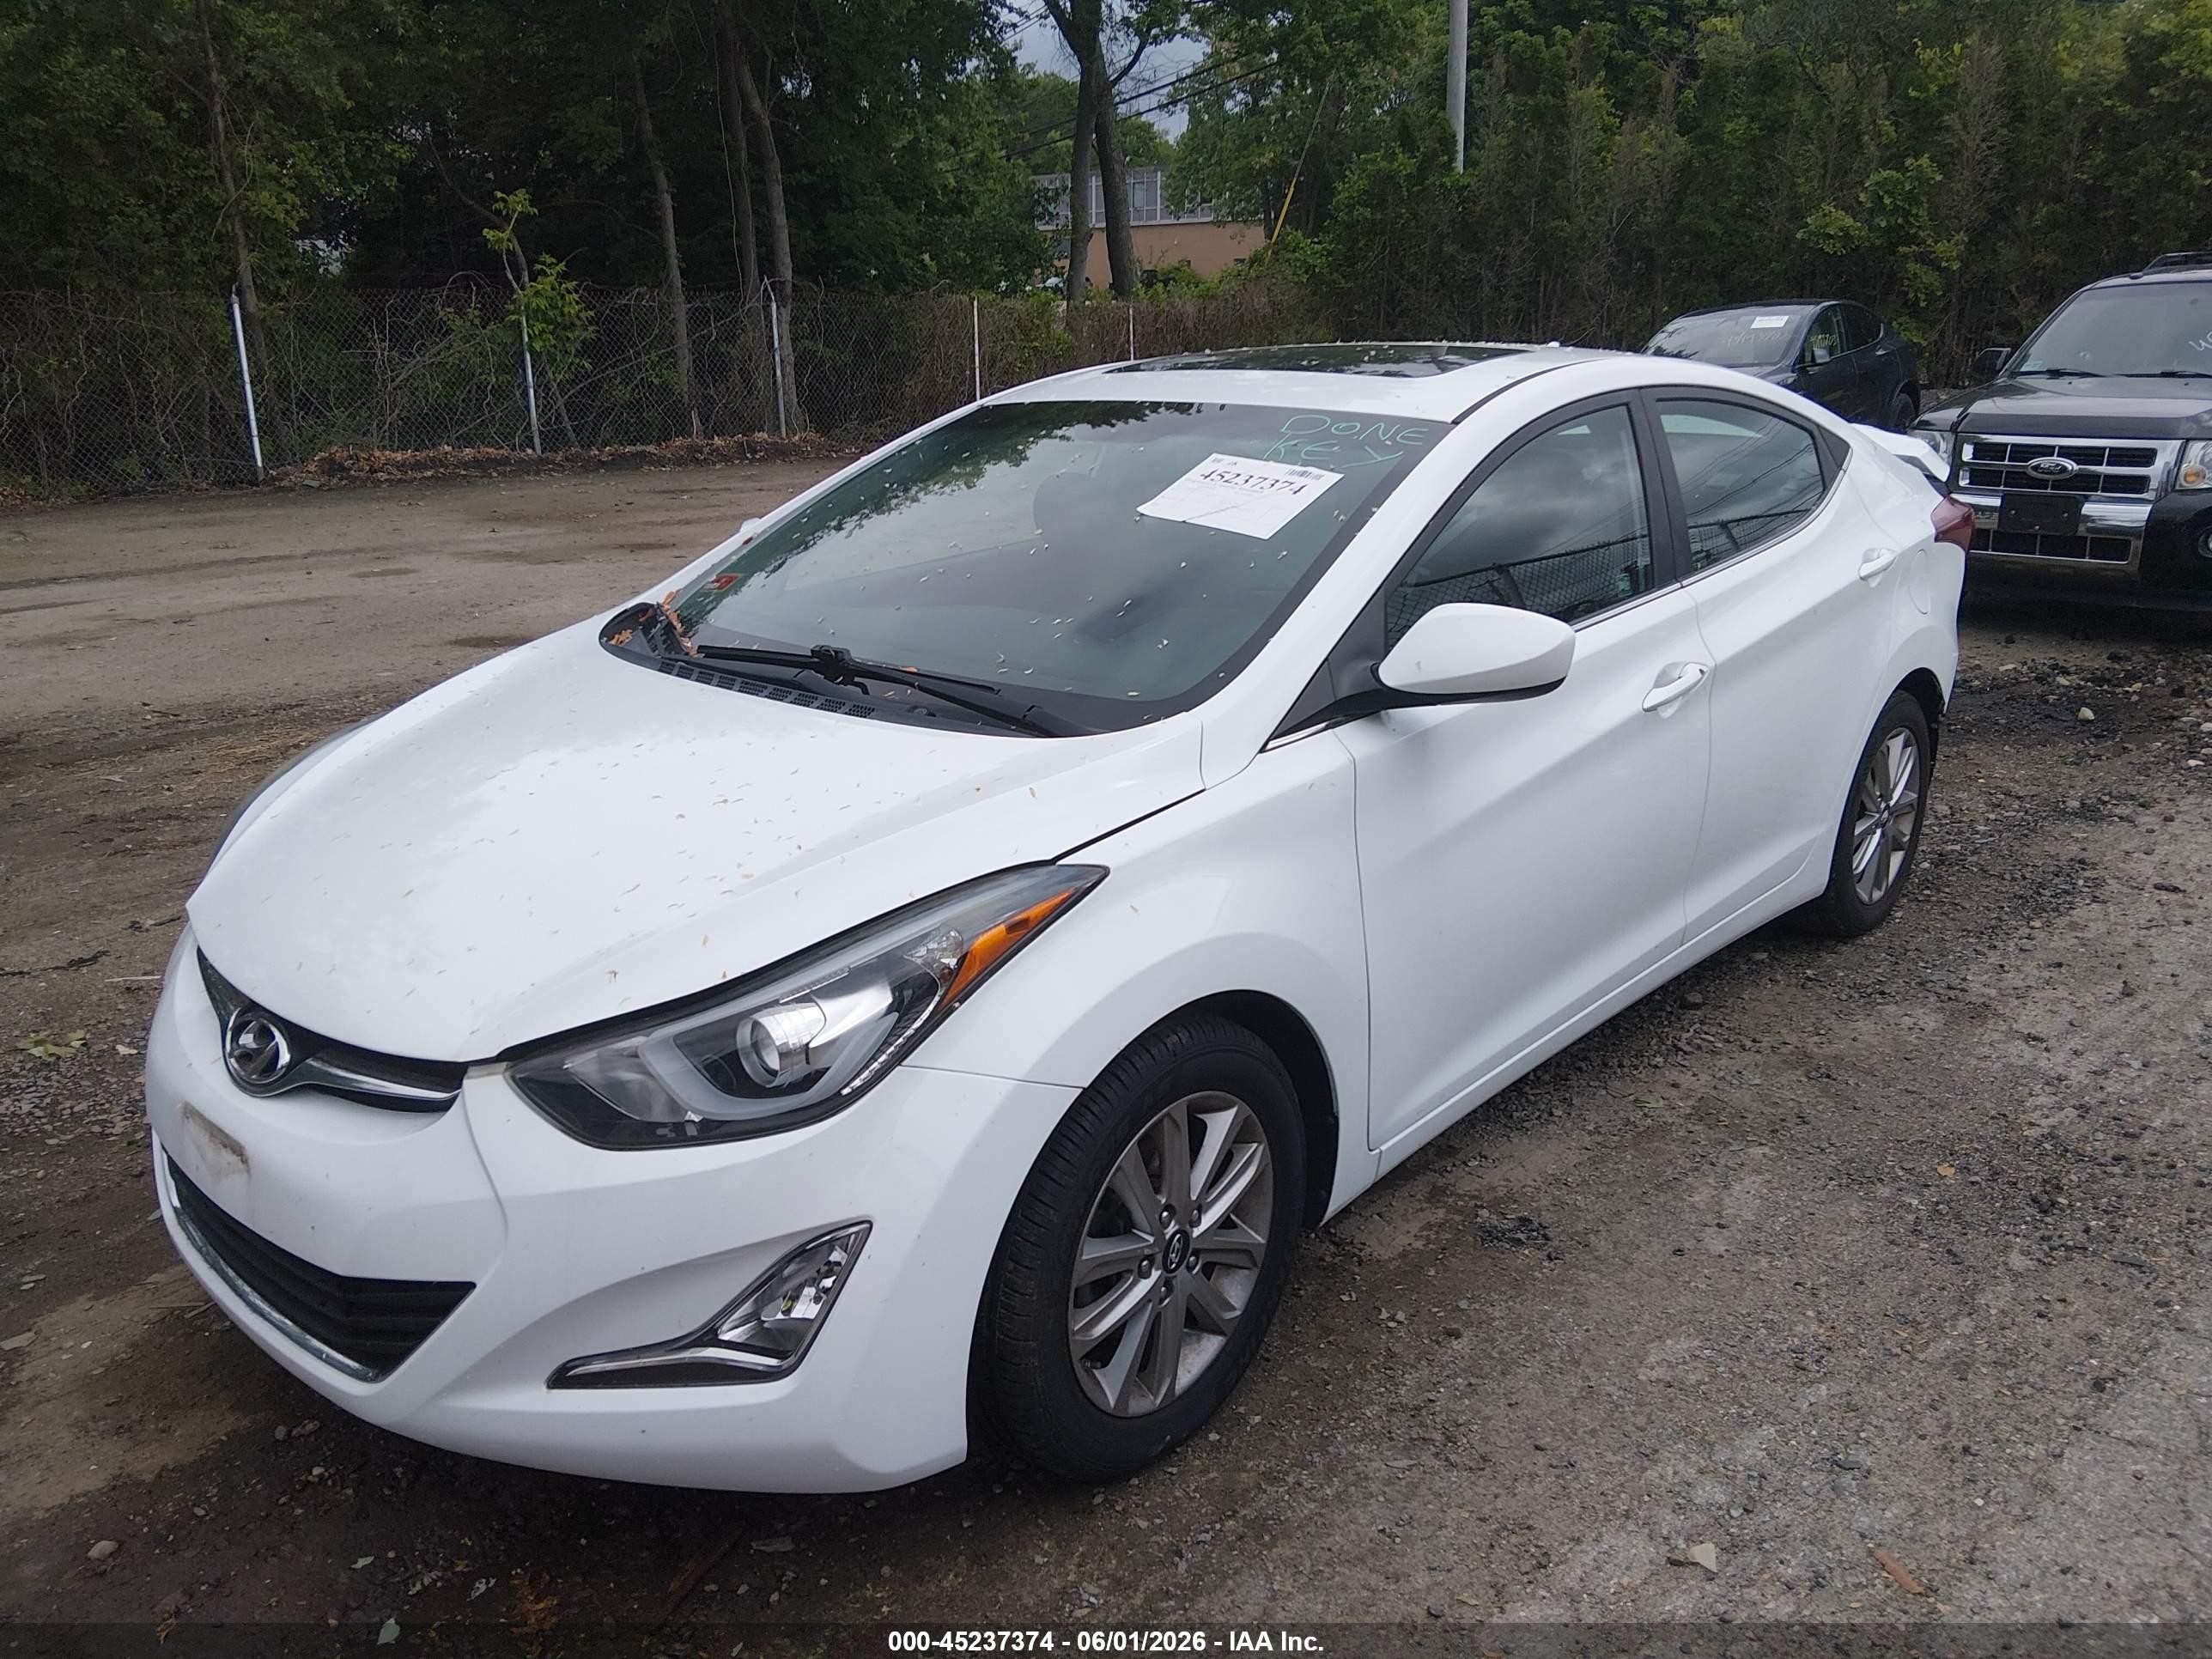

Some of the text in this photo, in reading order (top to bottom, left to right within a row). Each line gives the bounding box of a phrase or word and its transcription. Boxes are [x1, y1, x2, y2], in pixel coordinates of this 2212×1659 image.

[1280, 414, 1430, 446] DONE
[1263, 433, 1404, 469] KEY
[1200, 468, 1309, 495] 45237374
